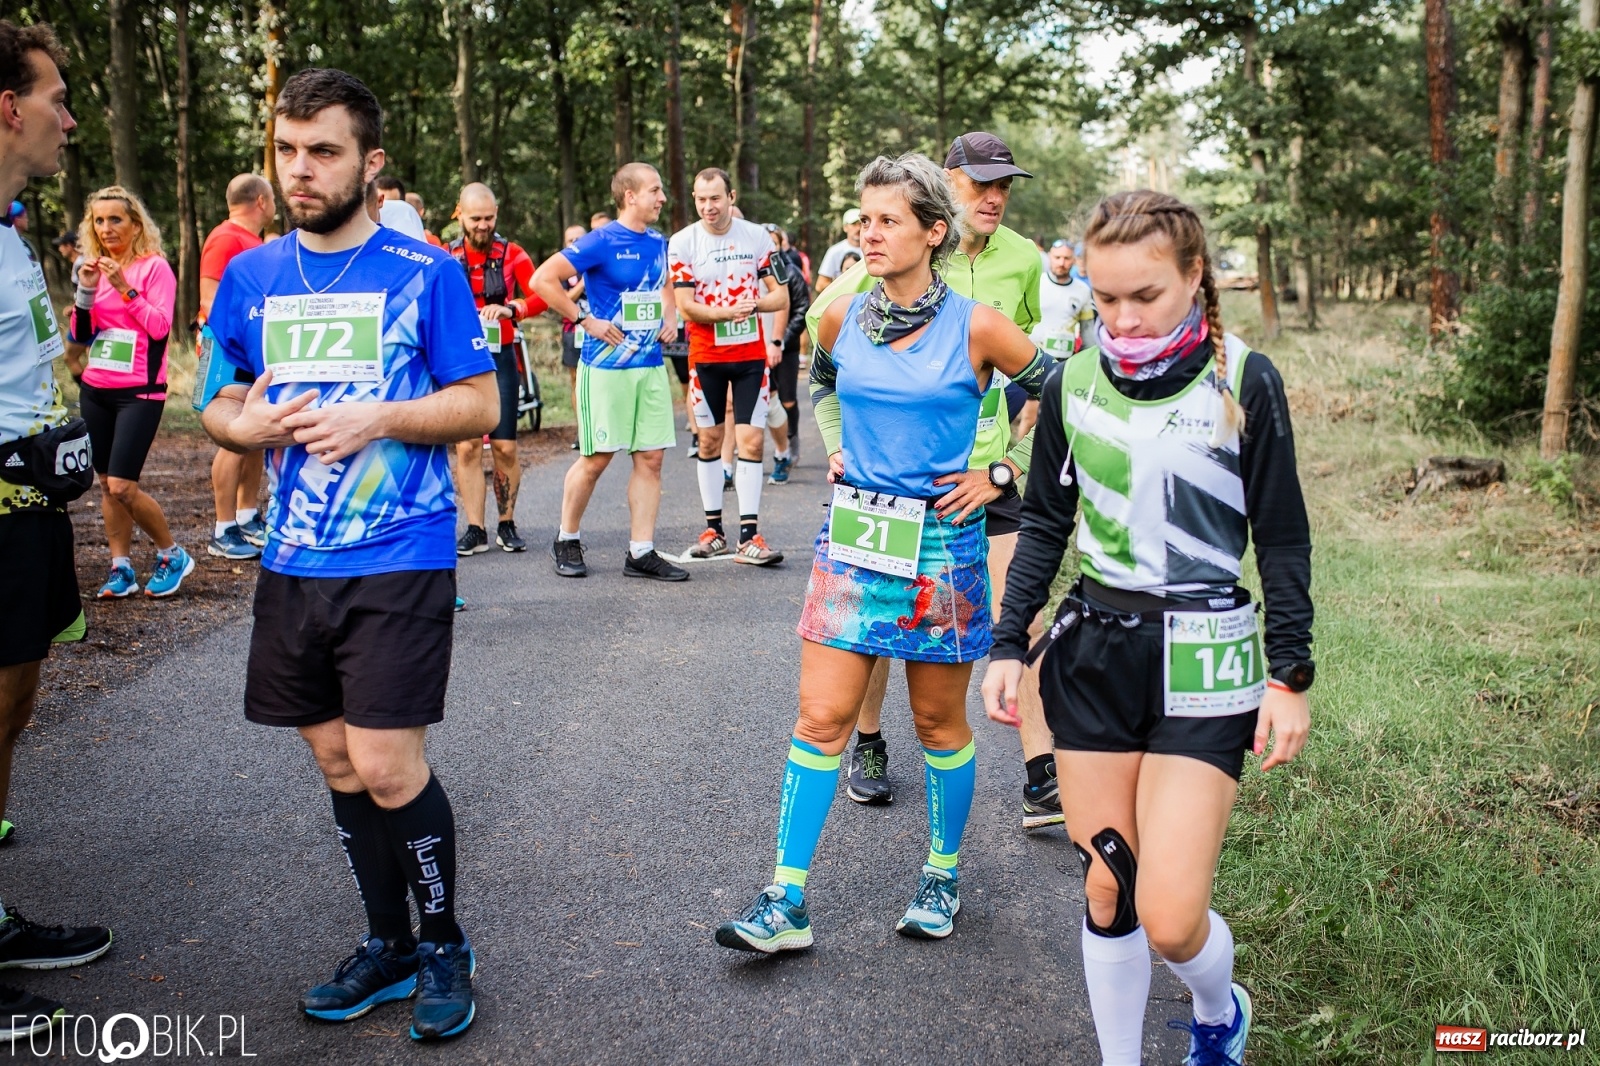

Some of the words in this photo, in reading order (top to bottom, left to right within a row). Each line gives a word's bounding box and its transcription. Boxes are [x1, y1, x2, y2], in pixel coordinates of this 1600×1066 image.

[382, 245, 434, 265] 13.10.2019
[299, 299, 308, 317] V
[637, 303, 655, 320] 68
[724, 319, 751, 336] 109
[101, 341, 112, 358] 5
[287, 321, 354, 358] 172
[856, 516, 889, 552] 21
[1207, 618, 1218, 639] V
[778, 768, 795, 848] COMPRESPORT
[930, 770, 940, 836] COMPRESPORT
[1103, 840, 1117, 855] KT
[406, 835, 446, 914] Kalenji
